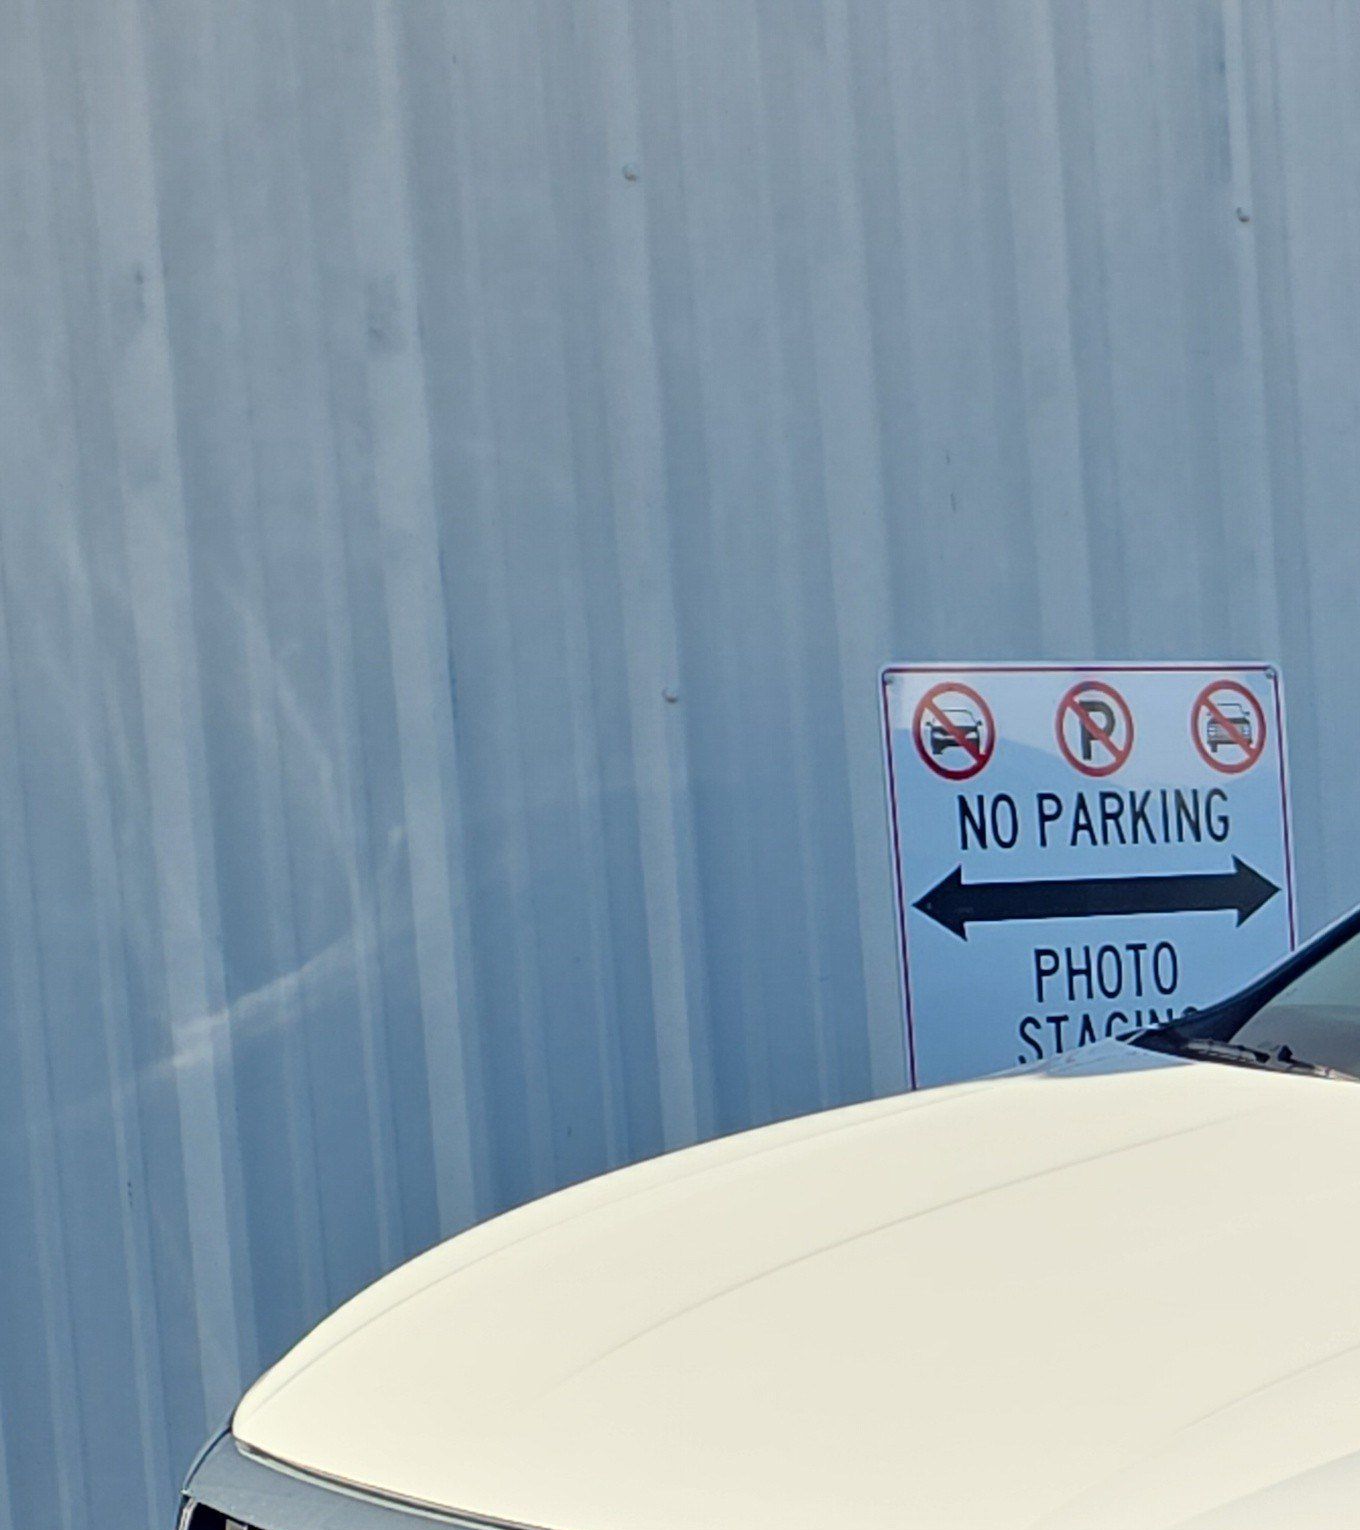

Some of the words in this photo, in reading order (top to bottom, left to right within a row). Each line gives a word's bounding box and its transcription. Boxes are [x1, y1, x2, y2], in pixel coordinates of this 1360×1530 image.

[957, 793, 1019, 850] NO
[1036, 788, 1230, 848] PARKING
[1034, 941, 1179, 1002] PHOTO
